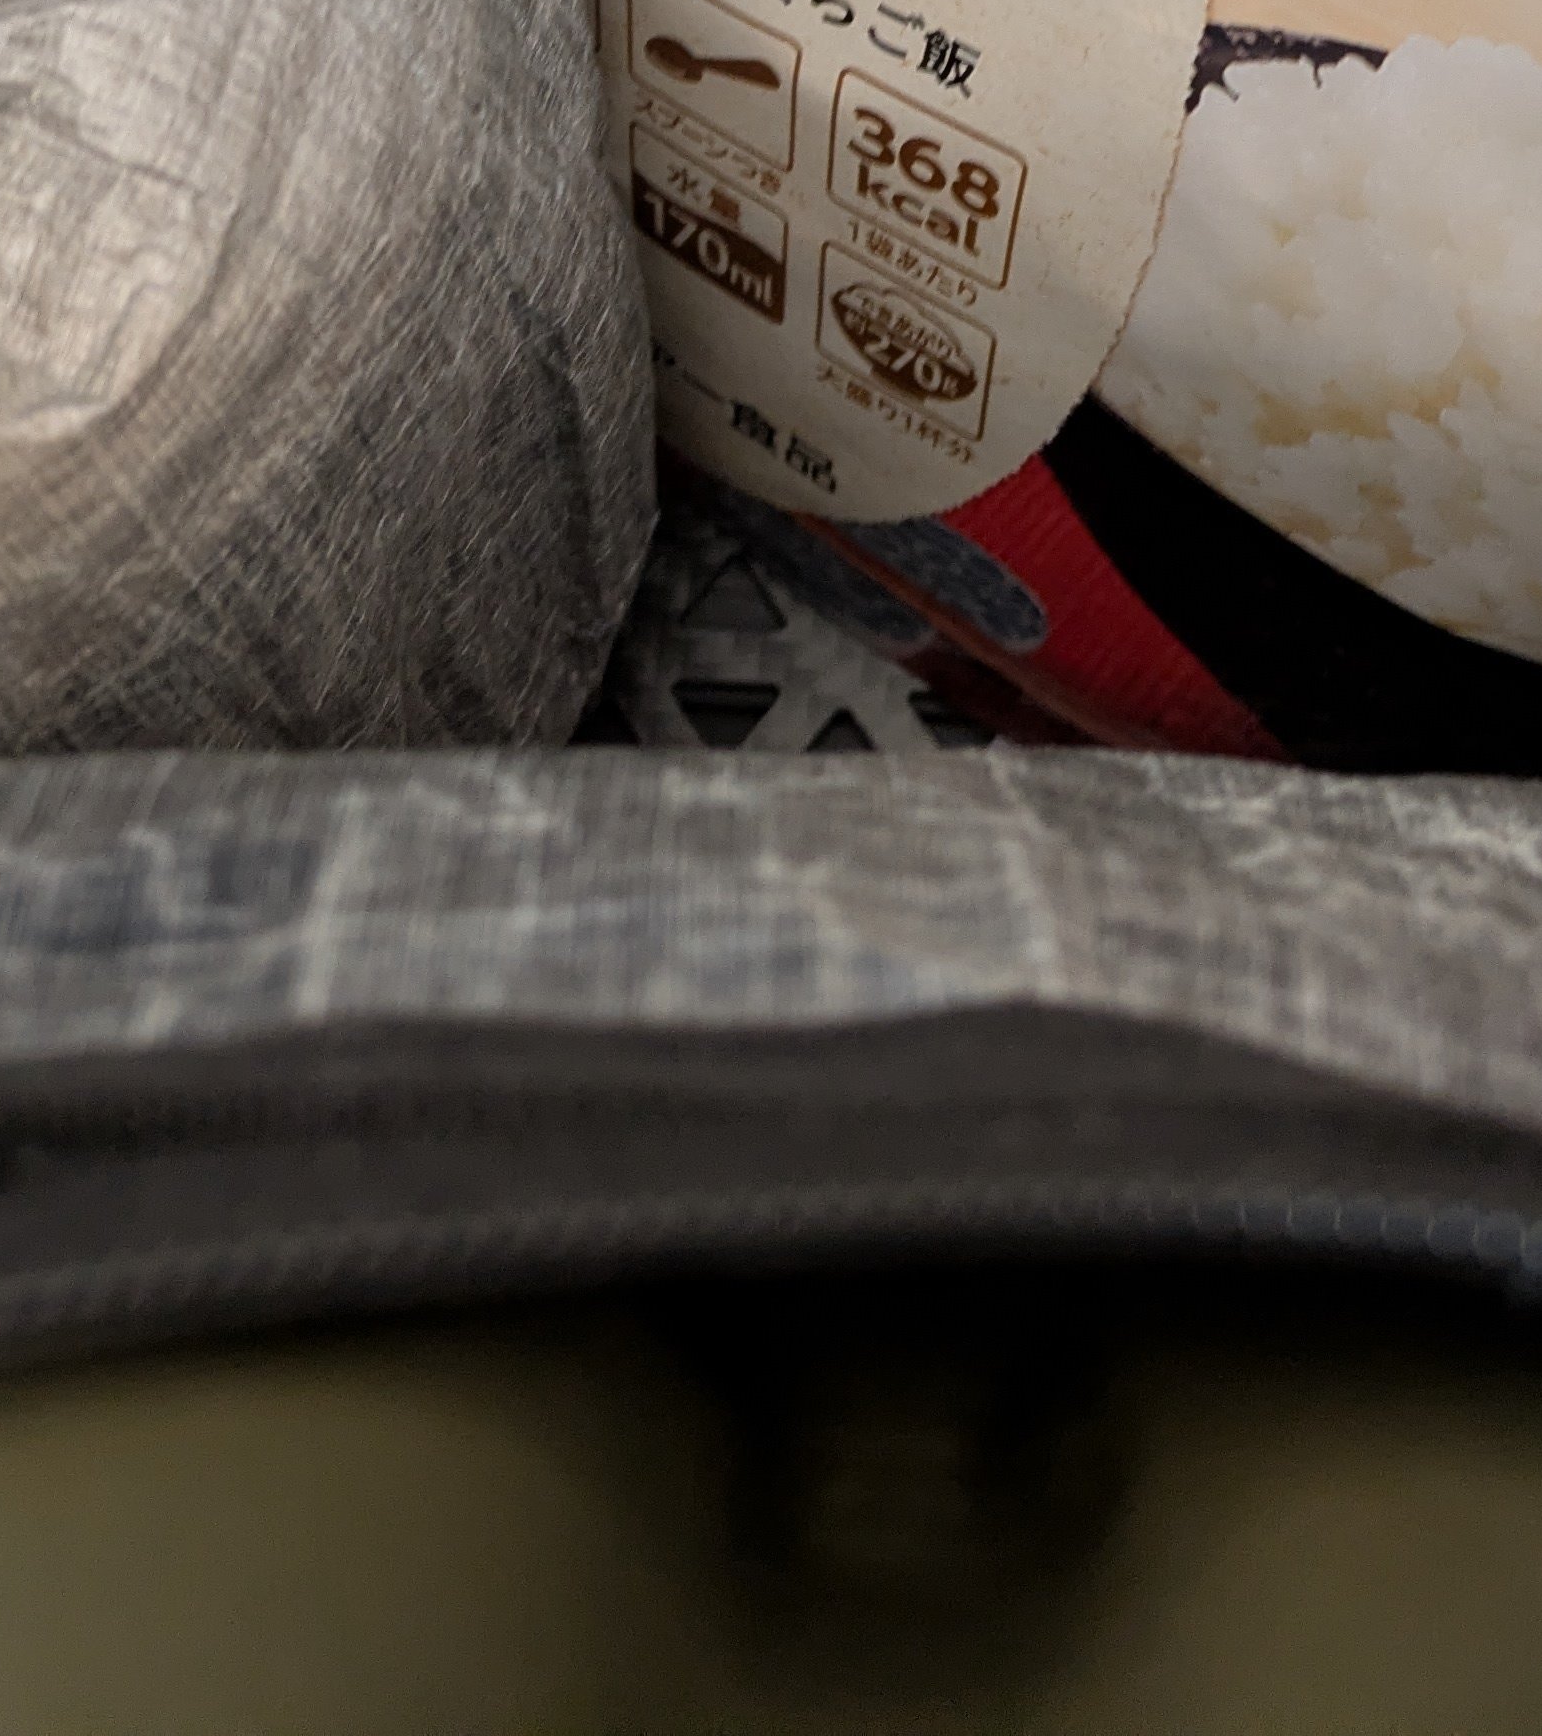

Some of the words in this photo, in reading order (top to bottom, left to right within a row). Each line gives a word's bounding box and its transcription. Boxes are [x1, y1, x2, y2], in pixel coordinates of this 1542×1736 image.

[846, 106, 1002, 220] 368
[856, 164, 982, 259] kcal
[643, 185, 775, 310] 170ml
